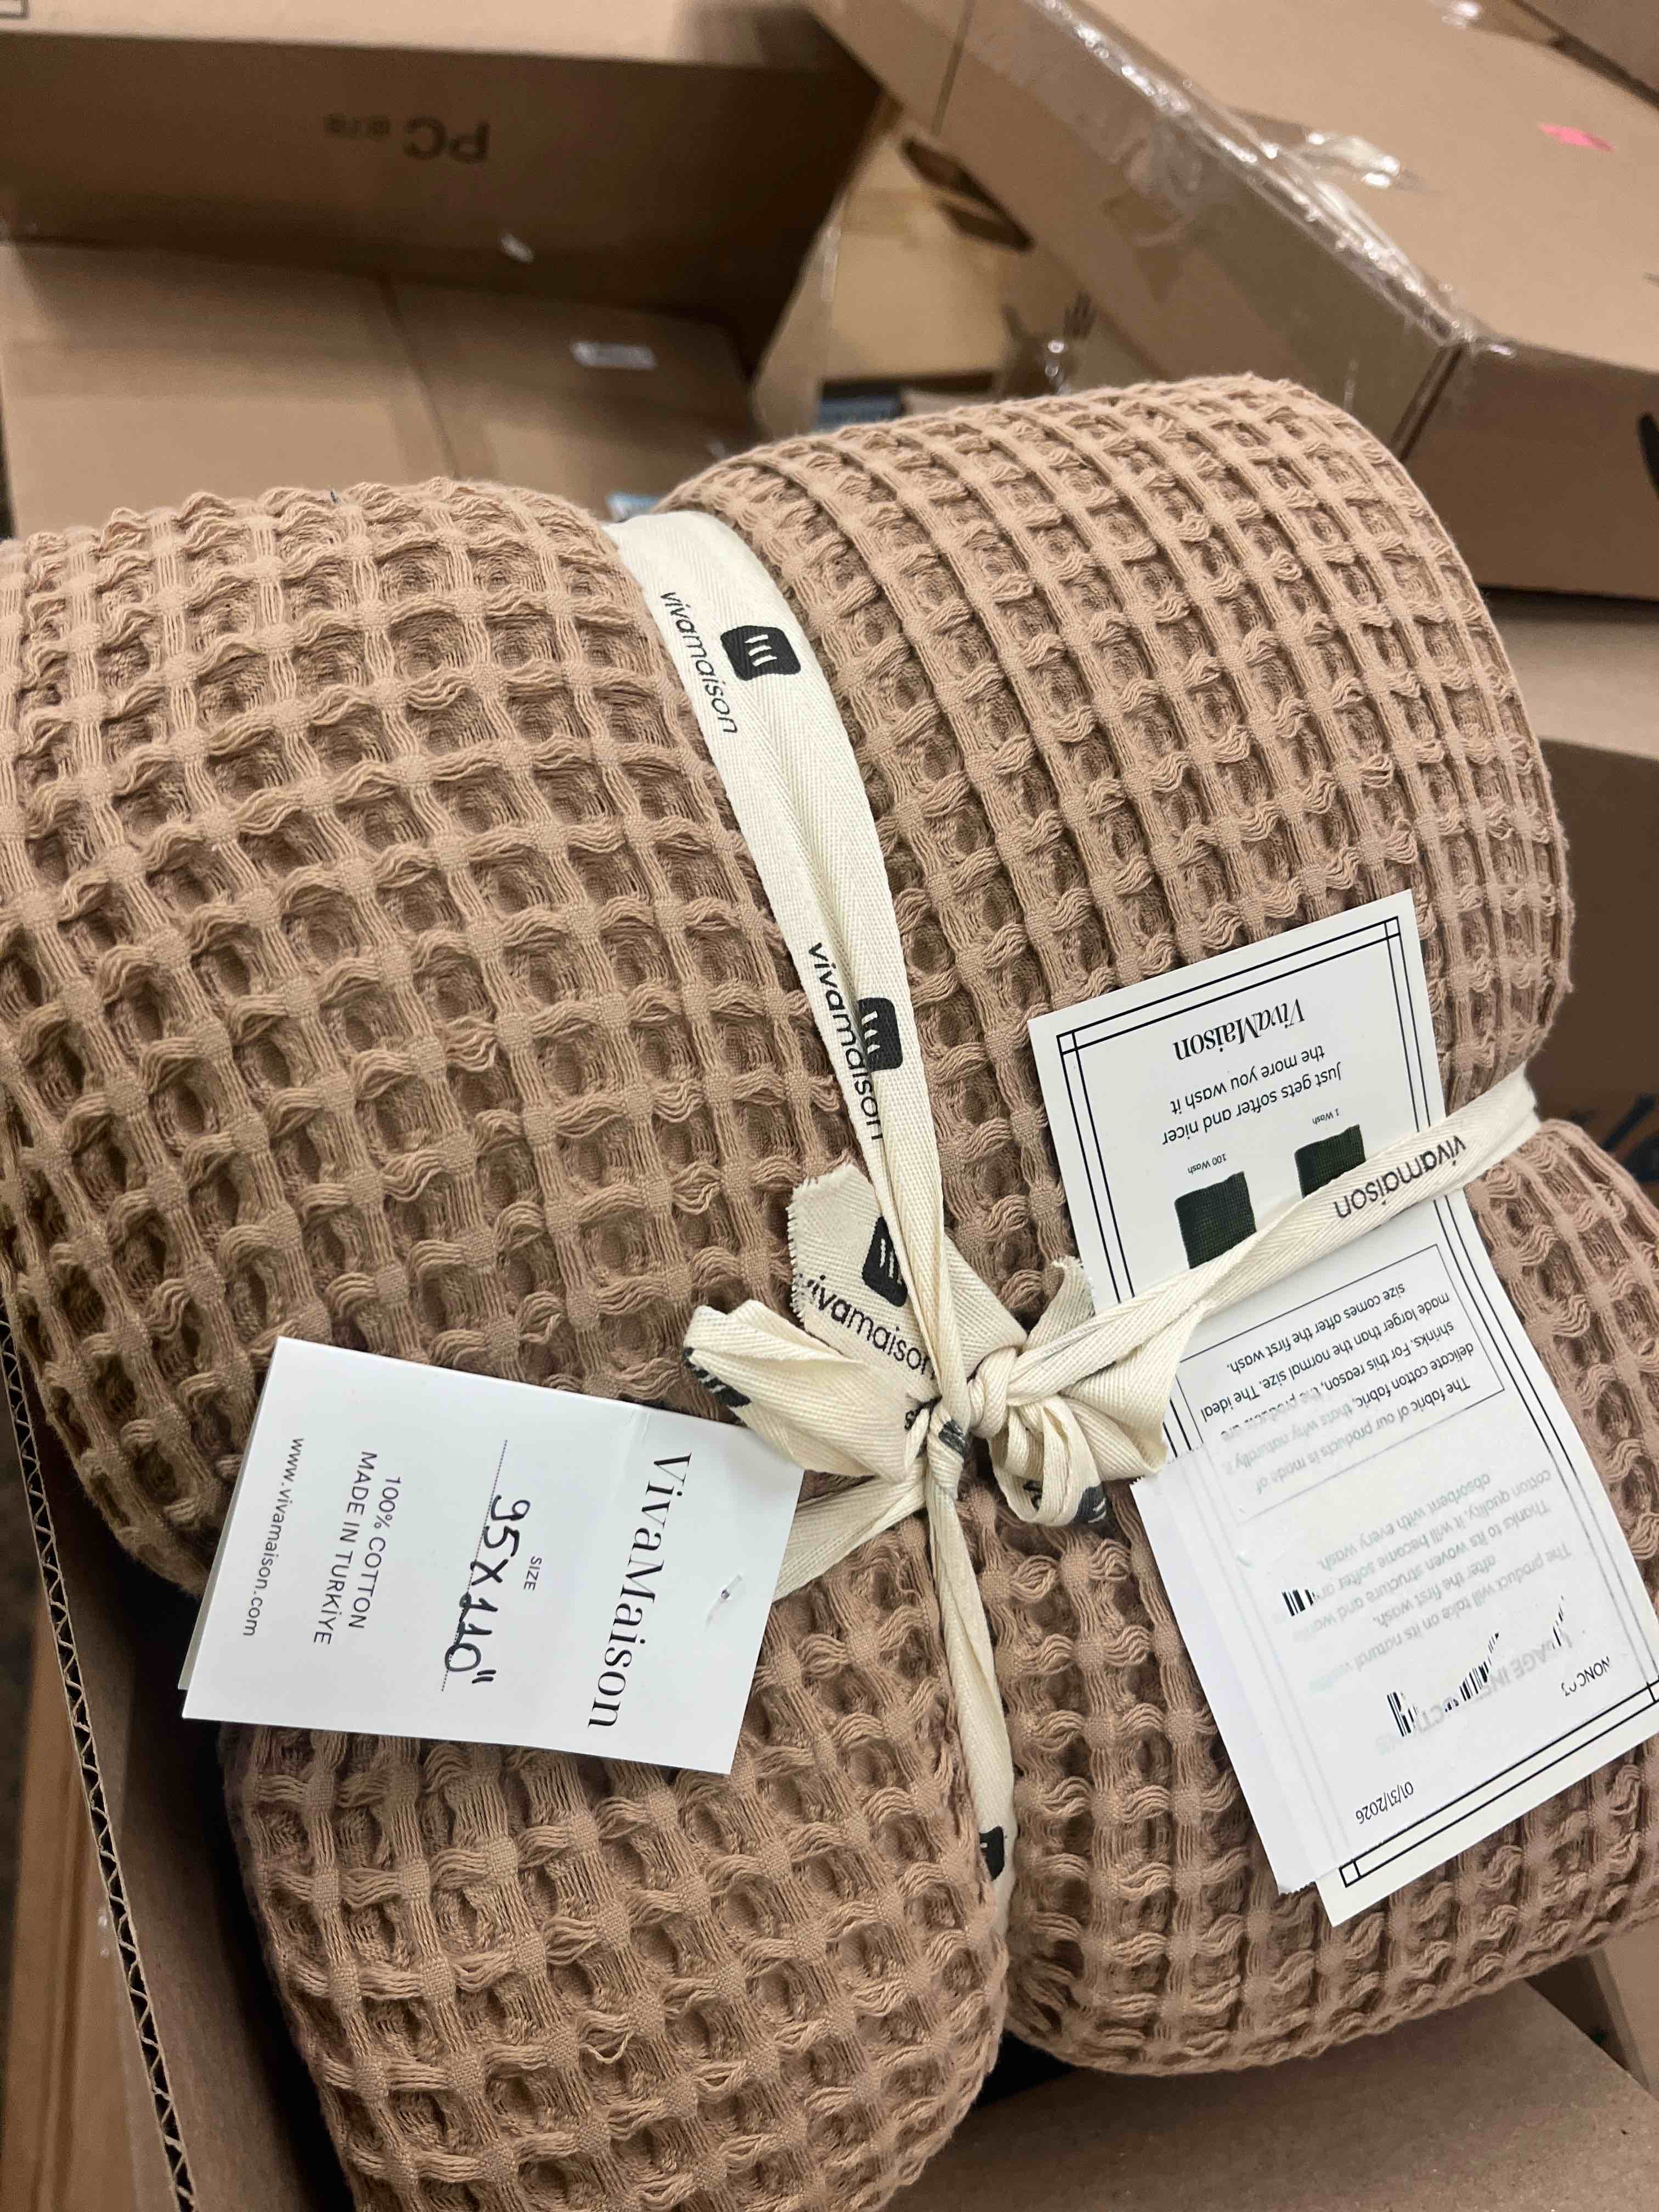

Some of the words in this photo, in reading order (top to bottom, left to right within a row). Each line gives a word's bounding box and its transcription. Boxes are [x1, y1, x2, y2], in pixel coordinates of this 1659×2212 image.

[403, 116, 490, 164] PC
[660, 592, 737, 733] vivamaison
[808, 942, 883, 1140] vivamaison
[1172, 998, 1305, 1060] VivaMaison
[1261, 1054, 1297, 1077] more
[1301, 1045, 1324, 1062] the
[1230, 1065, 1257, 1090] you
[1281, 1074, 1311, 1098] gets
[1314, 1061, 1341, 1087] Just
[1170, 1098, 1181, 1114] it
[1184, 1082, 1227, 1109] wash
[1236, 1091, 1277, 1116] softer
[1203, 1109, 1231, 1133] and
[1312, 1111, 1333, 1125] Wash
[1163, 1120, 1198, 1144] nicer
[1187, 1160, 1210, 1174] Wash
[1212, 1153, 1226, 1165] 100
[1333, 1135, 1466, 1218] vivamaison
[1382, 1283, 1404, 1300] size
[1417, 1293, 1449, 1314] made
[1343, 1295, 1380, 1318] comes
[1314, 1313, 1341, 1333] after
[1383, 1308, 1418, 1331] larger
[1291, 1328, 1312, 1342] the
[1353, 1326, 1381, 1345] than
[1410, 1321, 1453, 1347] shrinks.
[1265, 1337, 1291, 1357] first
[1331, 1340, 1352, 1355] the
[1391, 1342, 1410, 1359] For
[1429, 1342, 1474, 1370] delicate
[1227, 1350, 1265, 1374] wash.
[1288, 1349, 1330, 1380] normal
[1366, 1353, 1389, 1370] this
[1259, 1370, 1286, 1389] size.
[1321, 1364, 1365, 1390] reason,
[1391, 1365, 1427, 1389] cotton
[1446, 1377, 1470, 1393] The
[1233, 1385, 1260, 1402] The
[1352, 1384, 1390, 1407] fabric,
[1410, 1388, 1445, 1411] fabric
[1200, 1397, 1233, 1422] ideal
[1397, 1406, 1409, 1422] of
[346, 1452, 377, 1515] MADE
[374, 1476, 400, 1528] 100%
[242, 1438, 303, 1635] www.vivamaison.com
[340, 1521, 359, 1542] IN
[348, 1537, 385, 1628] COTTON
[523, 1556, 541, 1590] SIZE
[588, 1452, 691, 1726] VivaMaison
[1356, 1781, 1413, 1824] 01/31/2026
